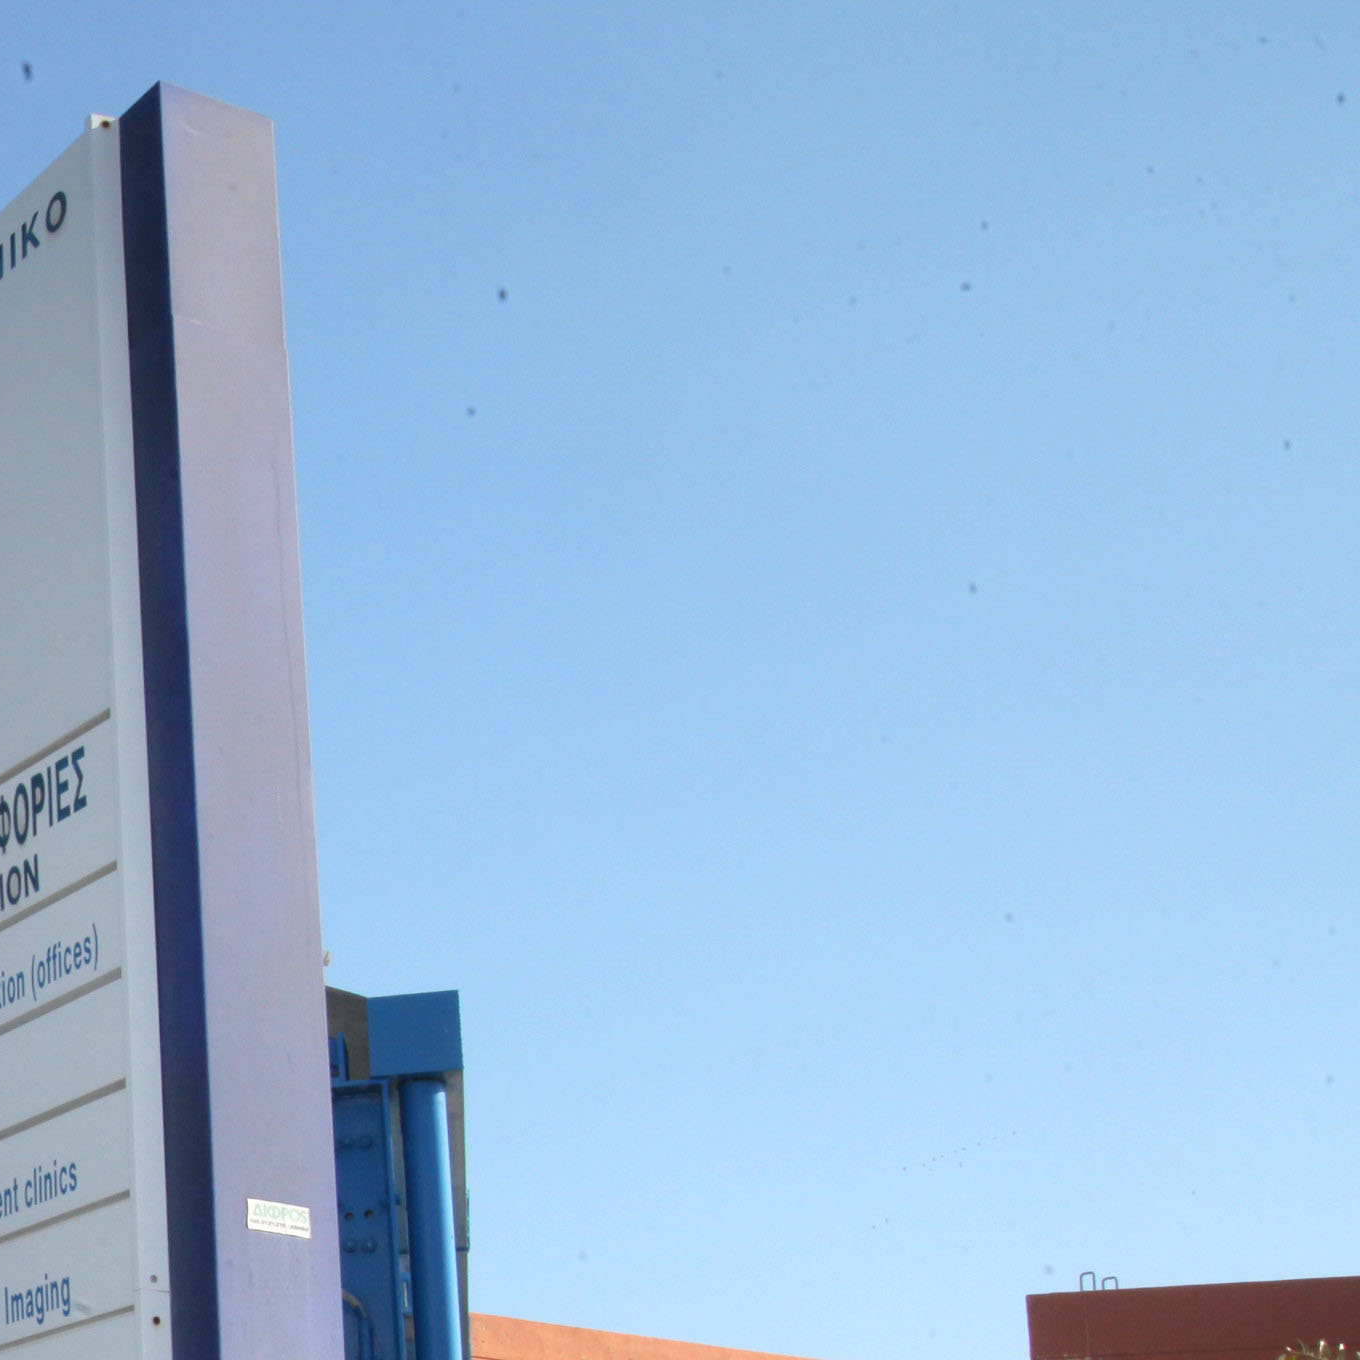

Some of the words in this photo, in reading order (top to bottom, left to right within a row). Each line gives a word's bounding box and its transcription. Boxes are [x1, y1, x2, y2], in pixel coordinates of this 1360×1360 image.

[30, 922, 99, 1001] (offices)
[24, 1160, 78, 1210] clinics
[4, 1272, 71, 1326] Imaging
